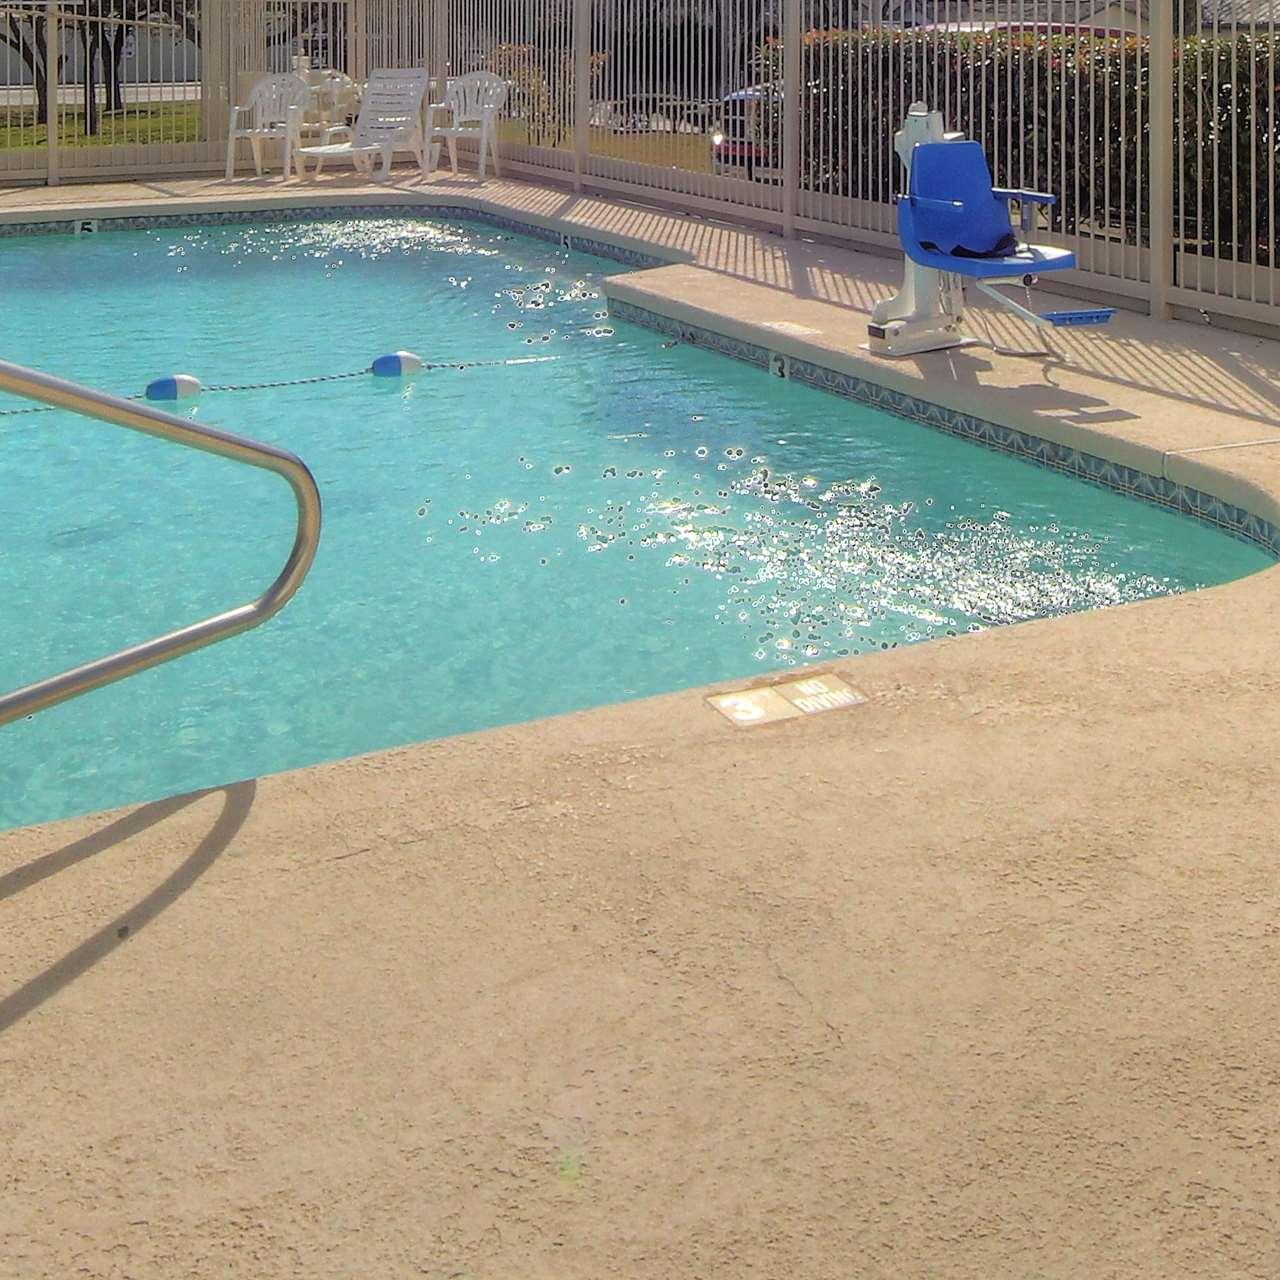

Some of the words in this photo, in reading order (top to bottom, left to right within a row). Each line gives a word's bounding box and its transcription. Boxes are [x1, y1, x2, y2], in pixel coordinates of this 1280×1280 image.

[81, 221, 93, 233] 5
[795, 679, 829, 697] NO
[720, 696, 766, 721] 3
[793, 689, 865, 714] DIVING
